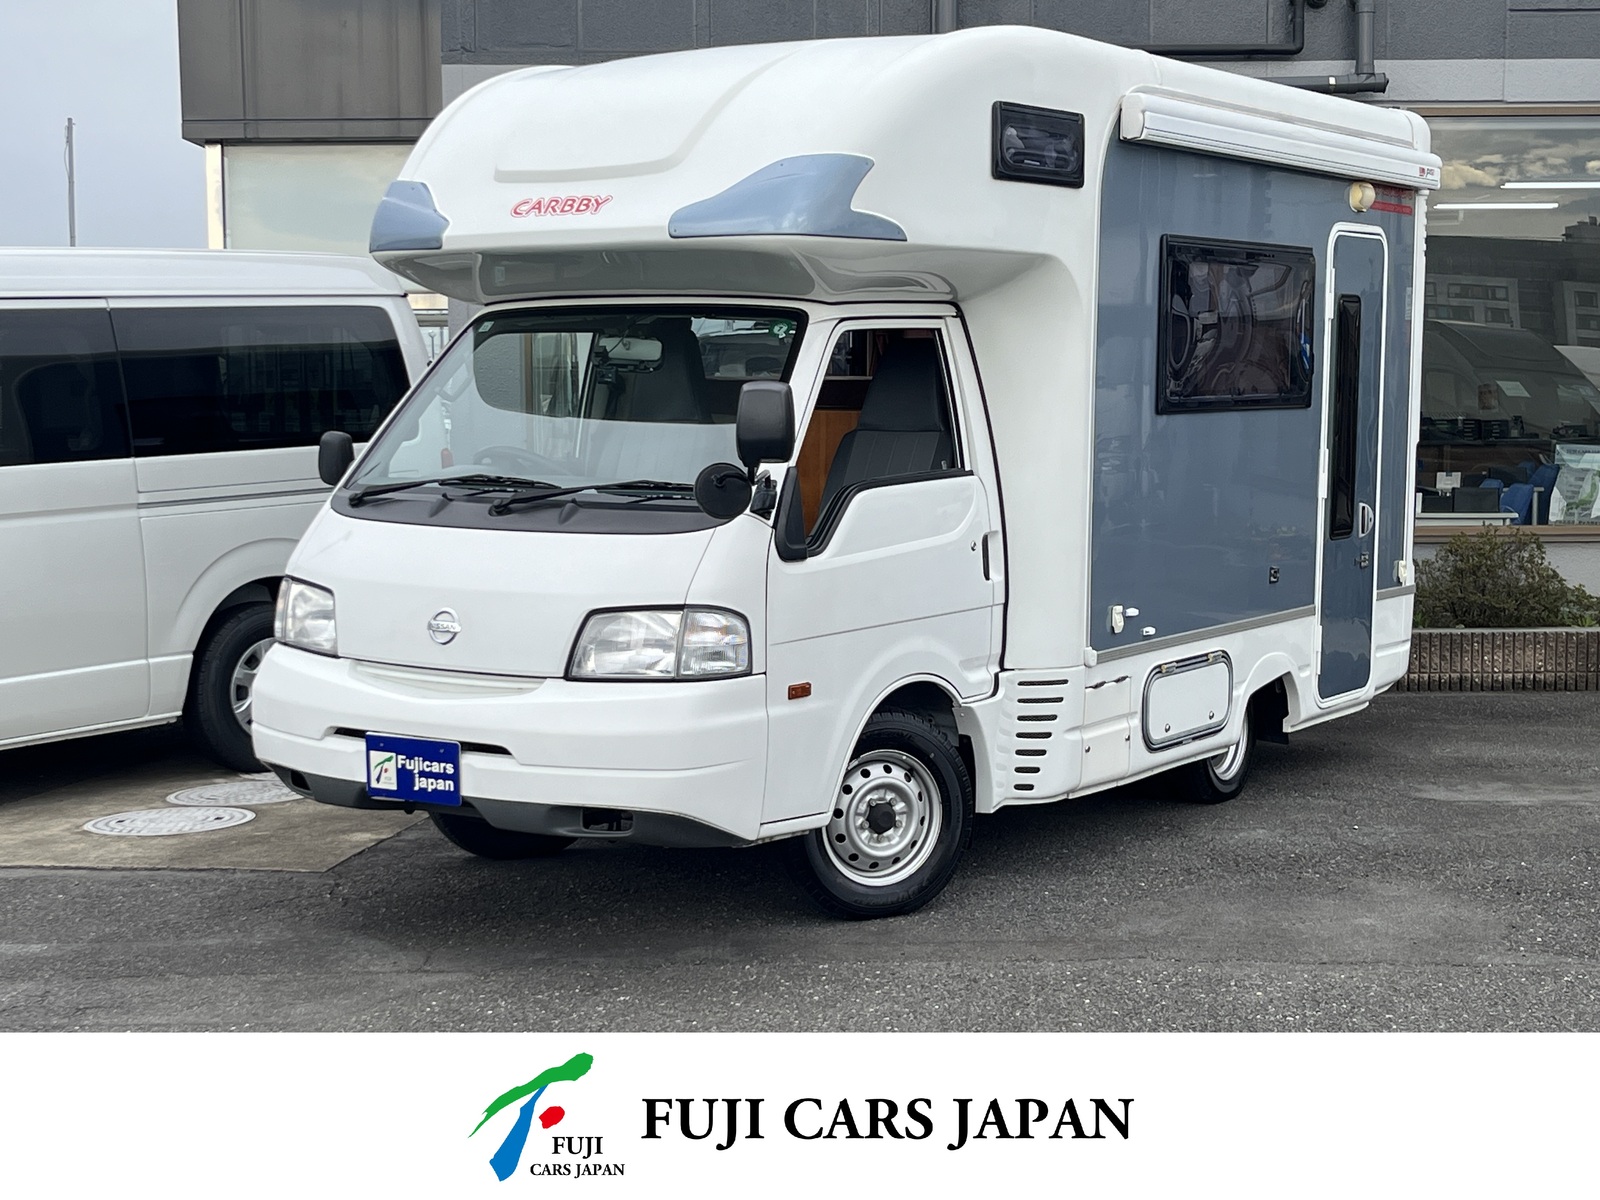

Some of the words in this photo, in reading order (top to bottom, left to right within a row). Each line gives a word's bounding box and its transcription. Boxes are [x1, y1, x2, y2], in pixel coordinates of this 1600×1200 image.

[511, 196, 613, 218] CARBBY
[397, 754, 455, 774] Fujicars
[413, 774, 455, 792] japan
